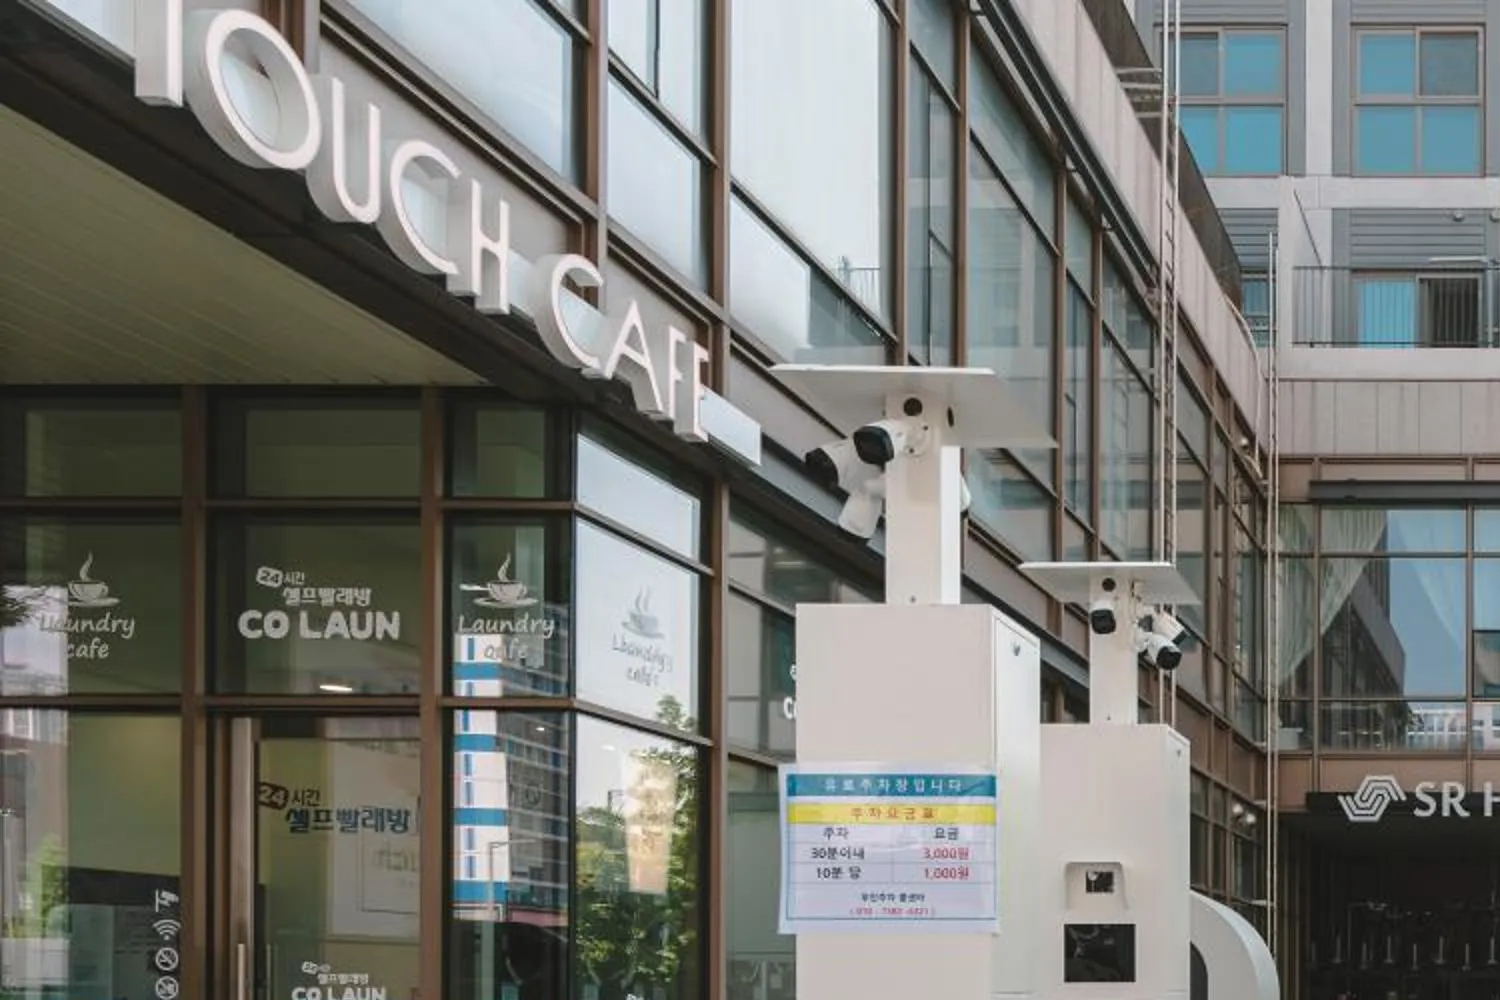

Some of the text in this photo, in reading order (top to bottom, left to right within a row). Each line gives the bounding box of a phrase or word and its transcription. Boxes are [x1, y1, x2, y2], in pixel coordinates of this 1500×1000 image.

[535, 254, 709, 442] CAFE
[282, 587, 372, 607] 셀프빨래방
[238, 609, 400, 640] CO LAUN
[459, 612, 554, 639] Laundry
[68, 637, 111, 659] cafe
[1413, 781, 1470, 817] SR
[286, 807, 411, 834] 셀프빨래방
[934, 827, 959, 841] 요금
[923, 847, 969, 861] 3,000원
[924, 866, 969, 880] 1,000원
